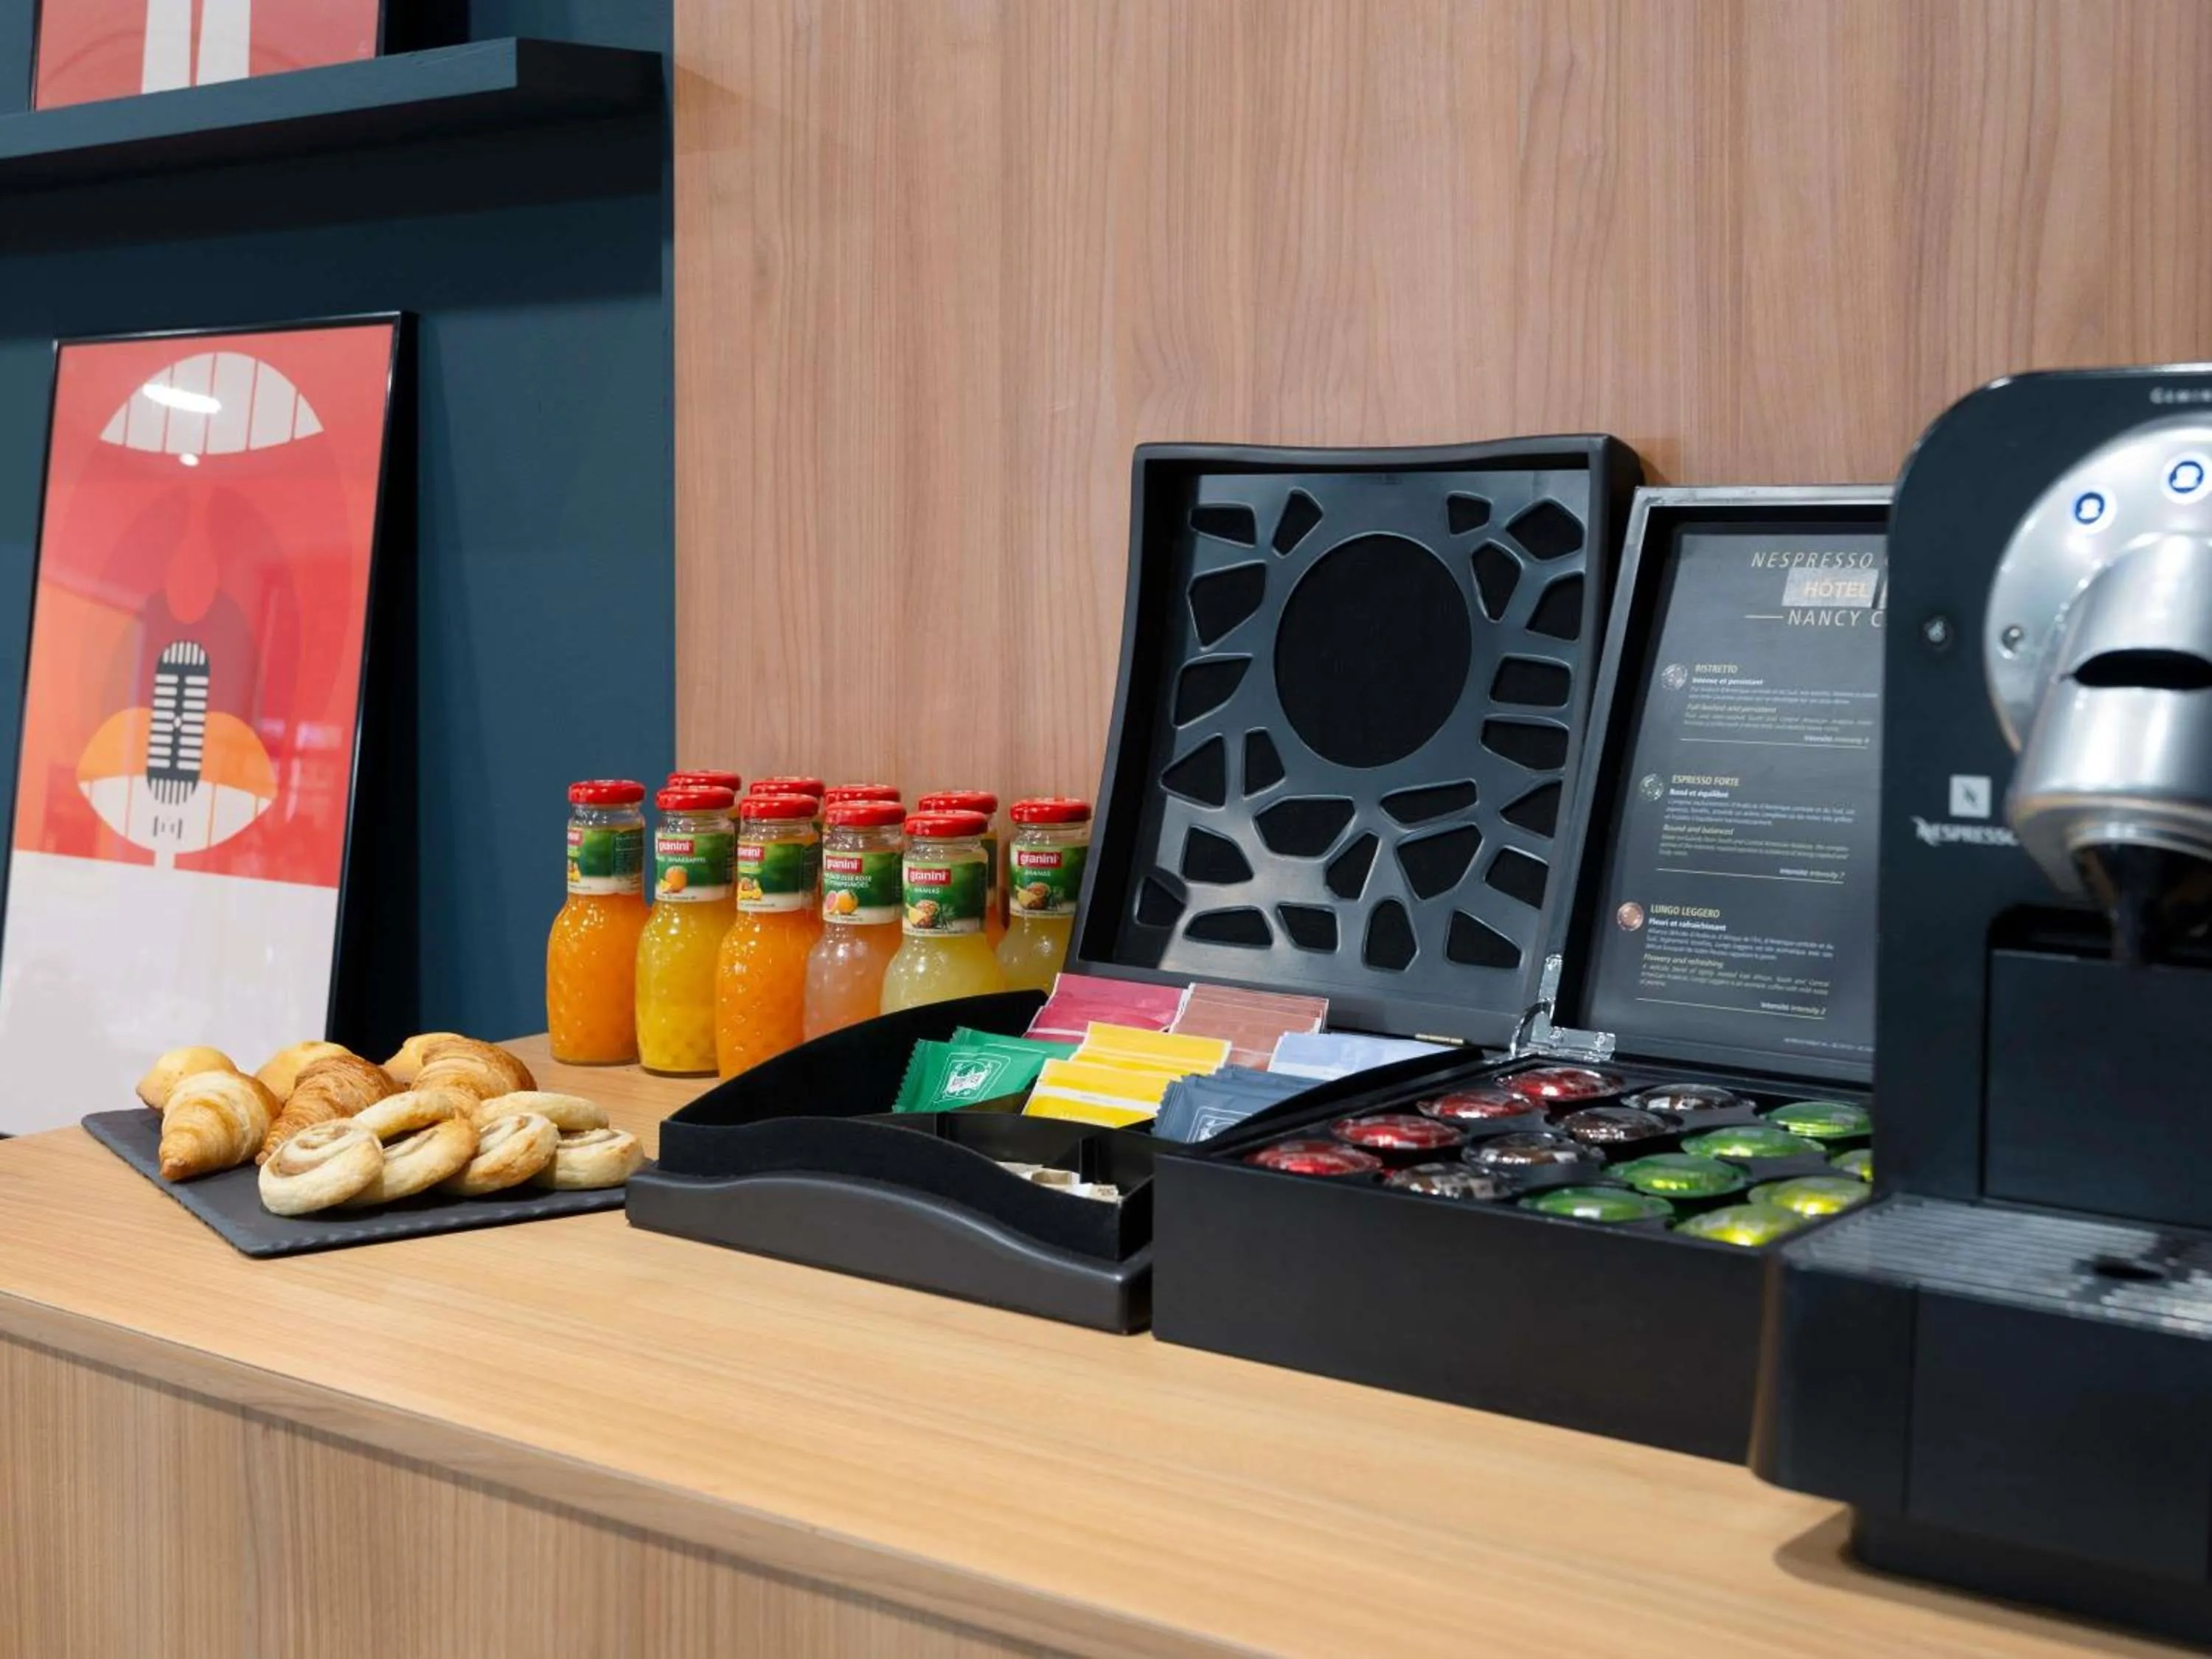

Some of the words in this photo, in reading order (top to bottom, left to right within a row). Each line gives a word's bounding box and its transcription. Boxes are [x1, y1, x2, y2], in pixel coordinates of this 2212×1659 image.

[1751, 552, 1874, 568] NESPRESSO
[1788, 610, 1862, 626] NANCY
[1871, 611, 1884, 627] C
[1672, 774, 1711, 785] ESPRESSO
[1714, 776, 1740, 787] FORTE
[1020, 853, 1057, 865] granini
[910, 871, 946, 882] granini
[1650, 904, 1680, 915] LUNGO
[1682, 907, 1720, 919] LEGGERO
